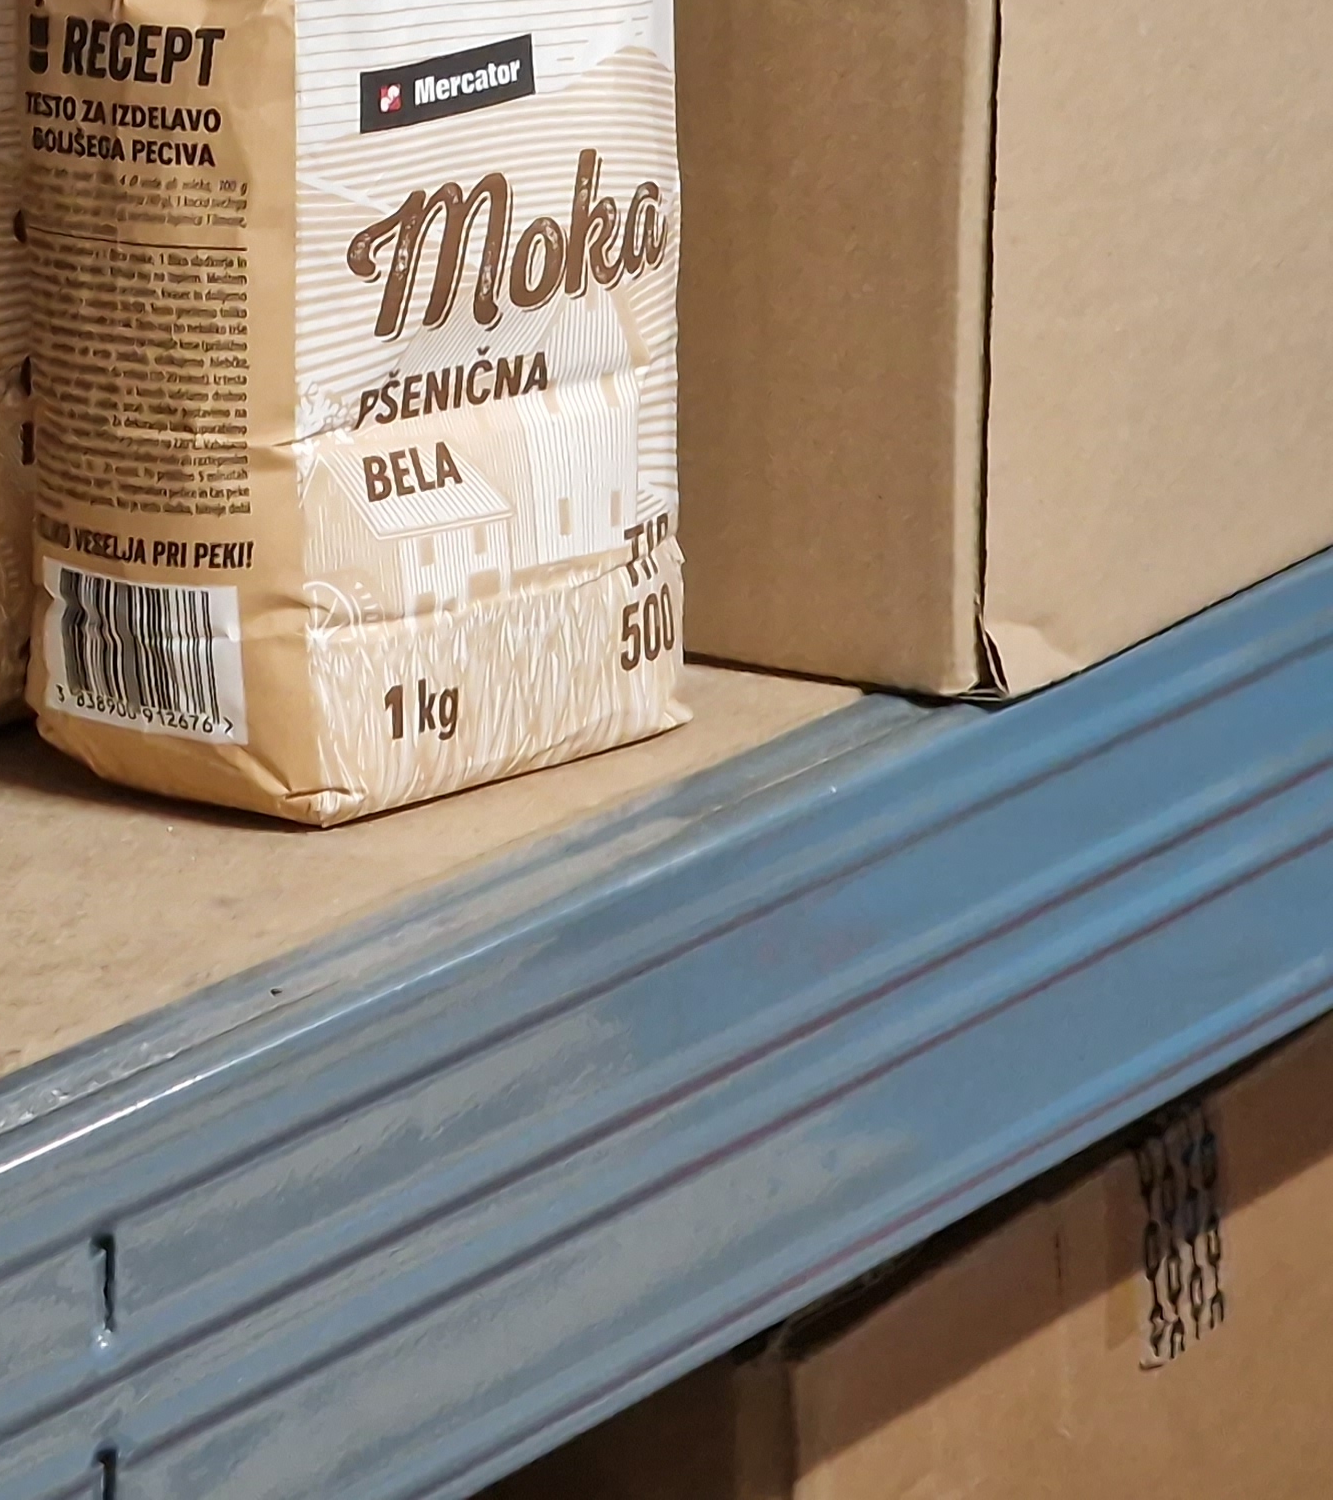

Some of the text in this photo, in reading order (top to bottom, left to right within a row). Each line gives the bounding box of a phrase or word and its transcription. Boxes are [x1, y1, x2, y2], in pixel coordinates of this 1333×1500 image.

[62, 14, 226, 87] RECEPT
[414, 56, 522, 107] Mercator
[25, 90, 222, 134] TESTO ZA IZDELAVO
[131, 139, 216, 168] PECIVA
[346, 147, 669, 342] Moka
[354, 348, 548, 430] PŠENIČNA
[363, 440, 463, 502] BELA
[74, 527, 147, 566] VESELJA
[152, 539, 188, 569] PRI
[194, 540, 254, 571] PEKI!
[623, 512, 669, 588] TIP
[620, 582, 675, 672] 500
[55, 684, 214, 734] 3 838900 912676
[384, 679, 460, 742] 1 kg
